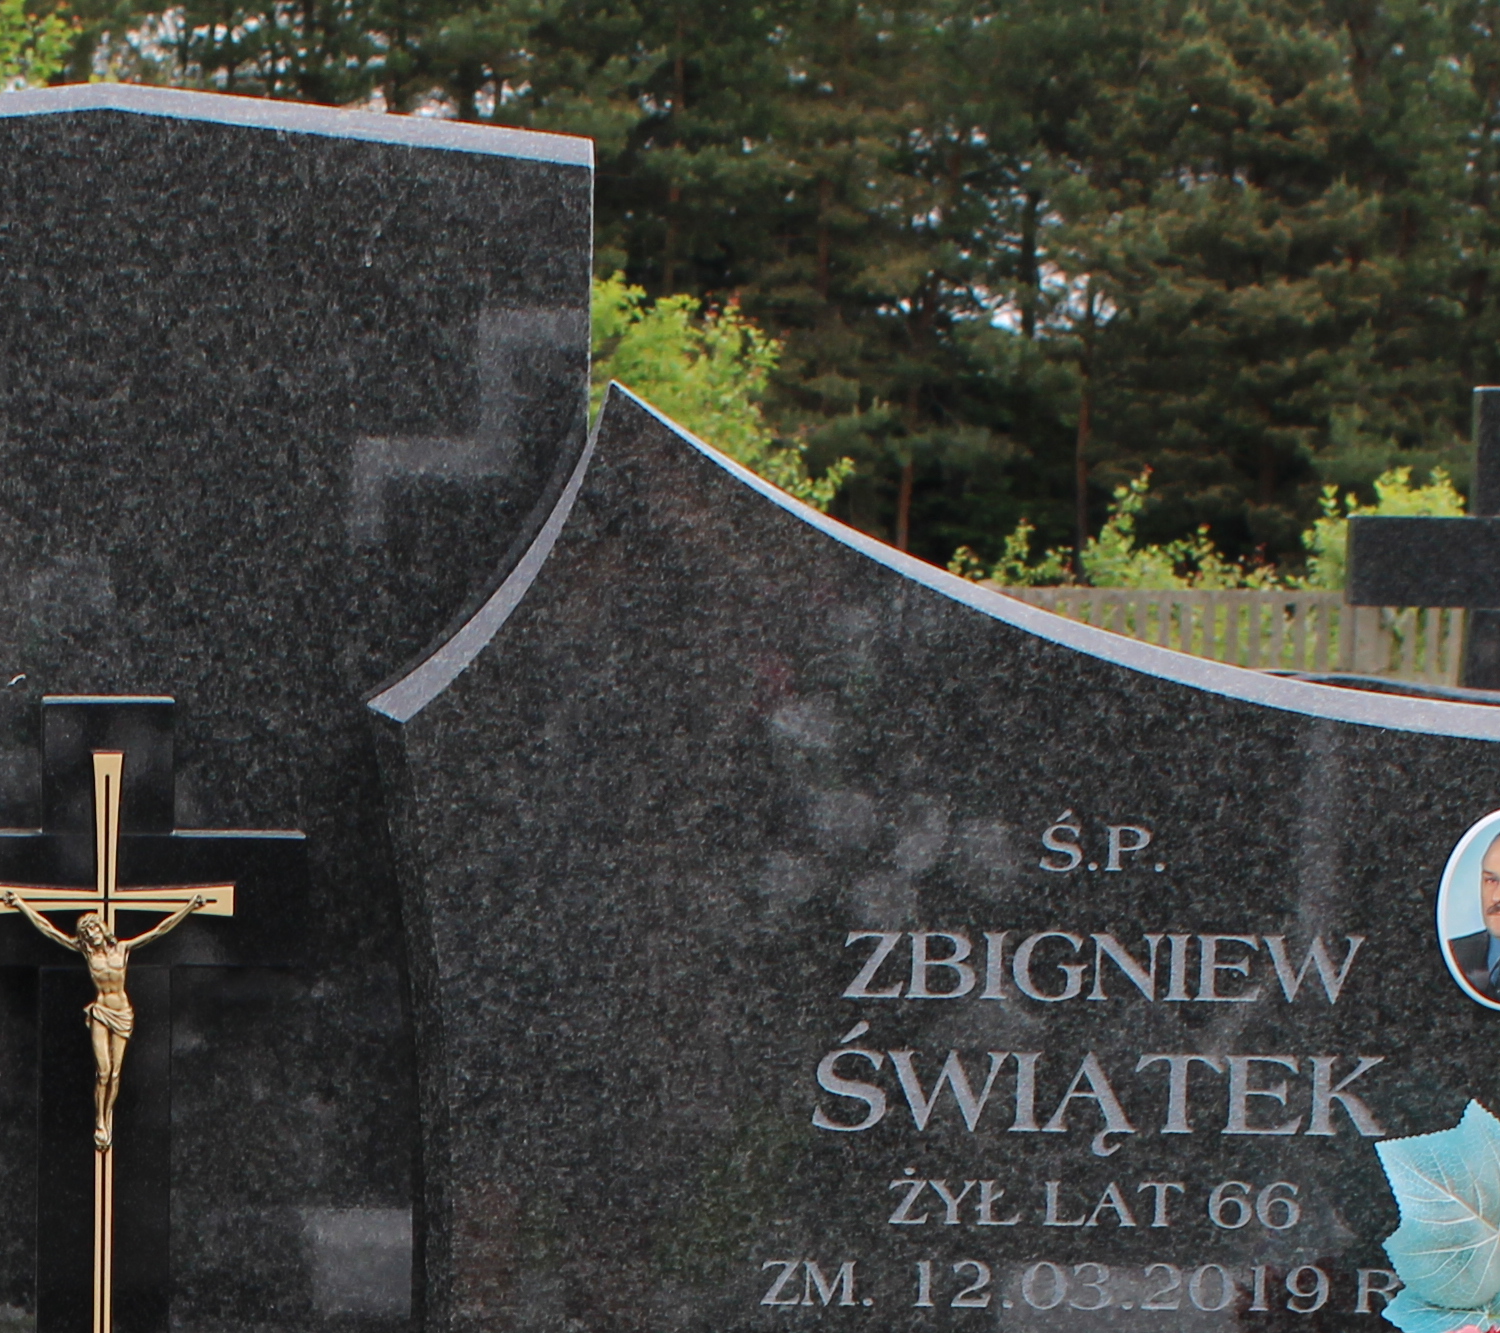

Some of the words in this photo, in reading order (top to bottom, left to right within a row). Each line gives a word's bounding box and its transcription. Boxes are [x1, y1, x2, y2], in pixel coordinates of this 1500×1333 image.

[843, 930, 1364, 1004] ZBIGNIEW
[812, 1022, 1386, 1158] ŚWIĄTEK
[889, 1168, 1021, 1226] ŻYŁ
[1043, 1181, 1185, 1227] LAT
[1209, 1181, 1301, 1230] 66
[761, 1260, 873, 1307] ZM.
